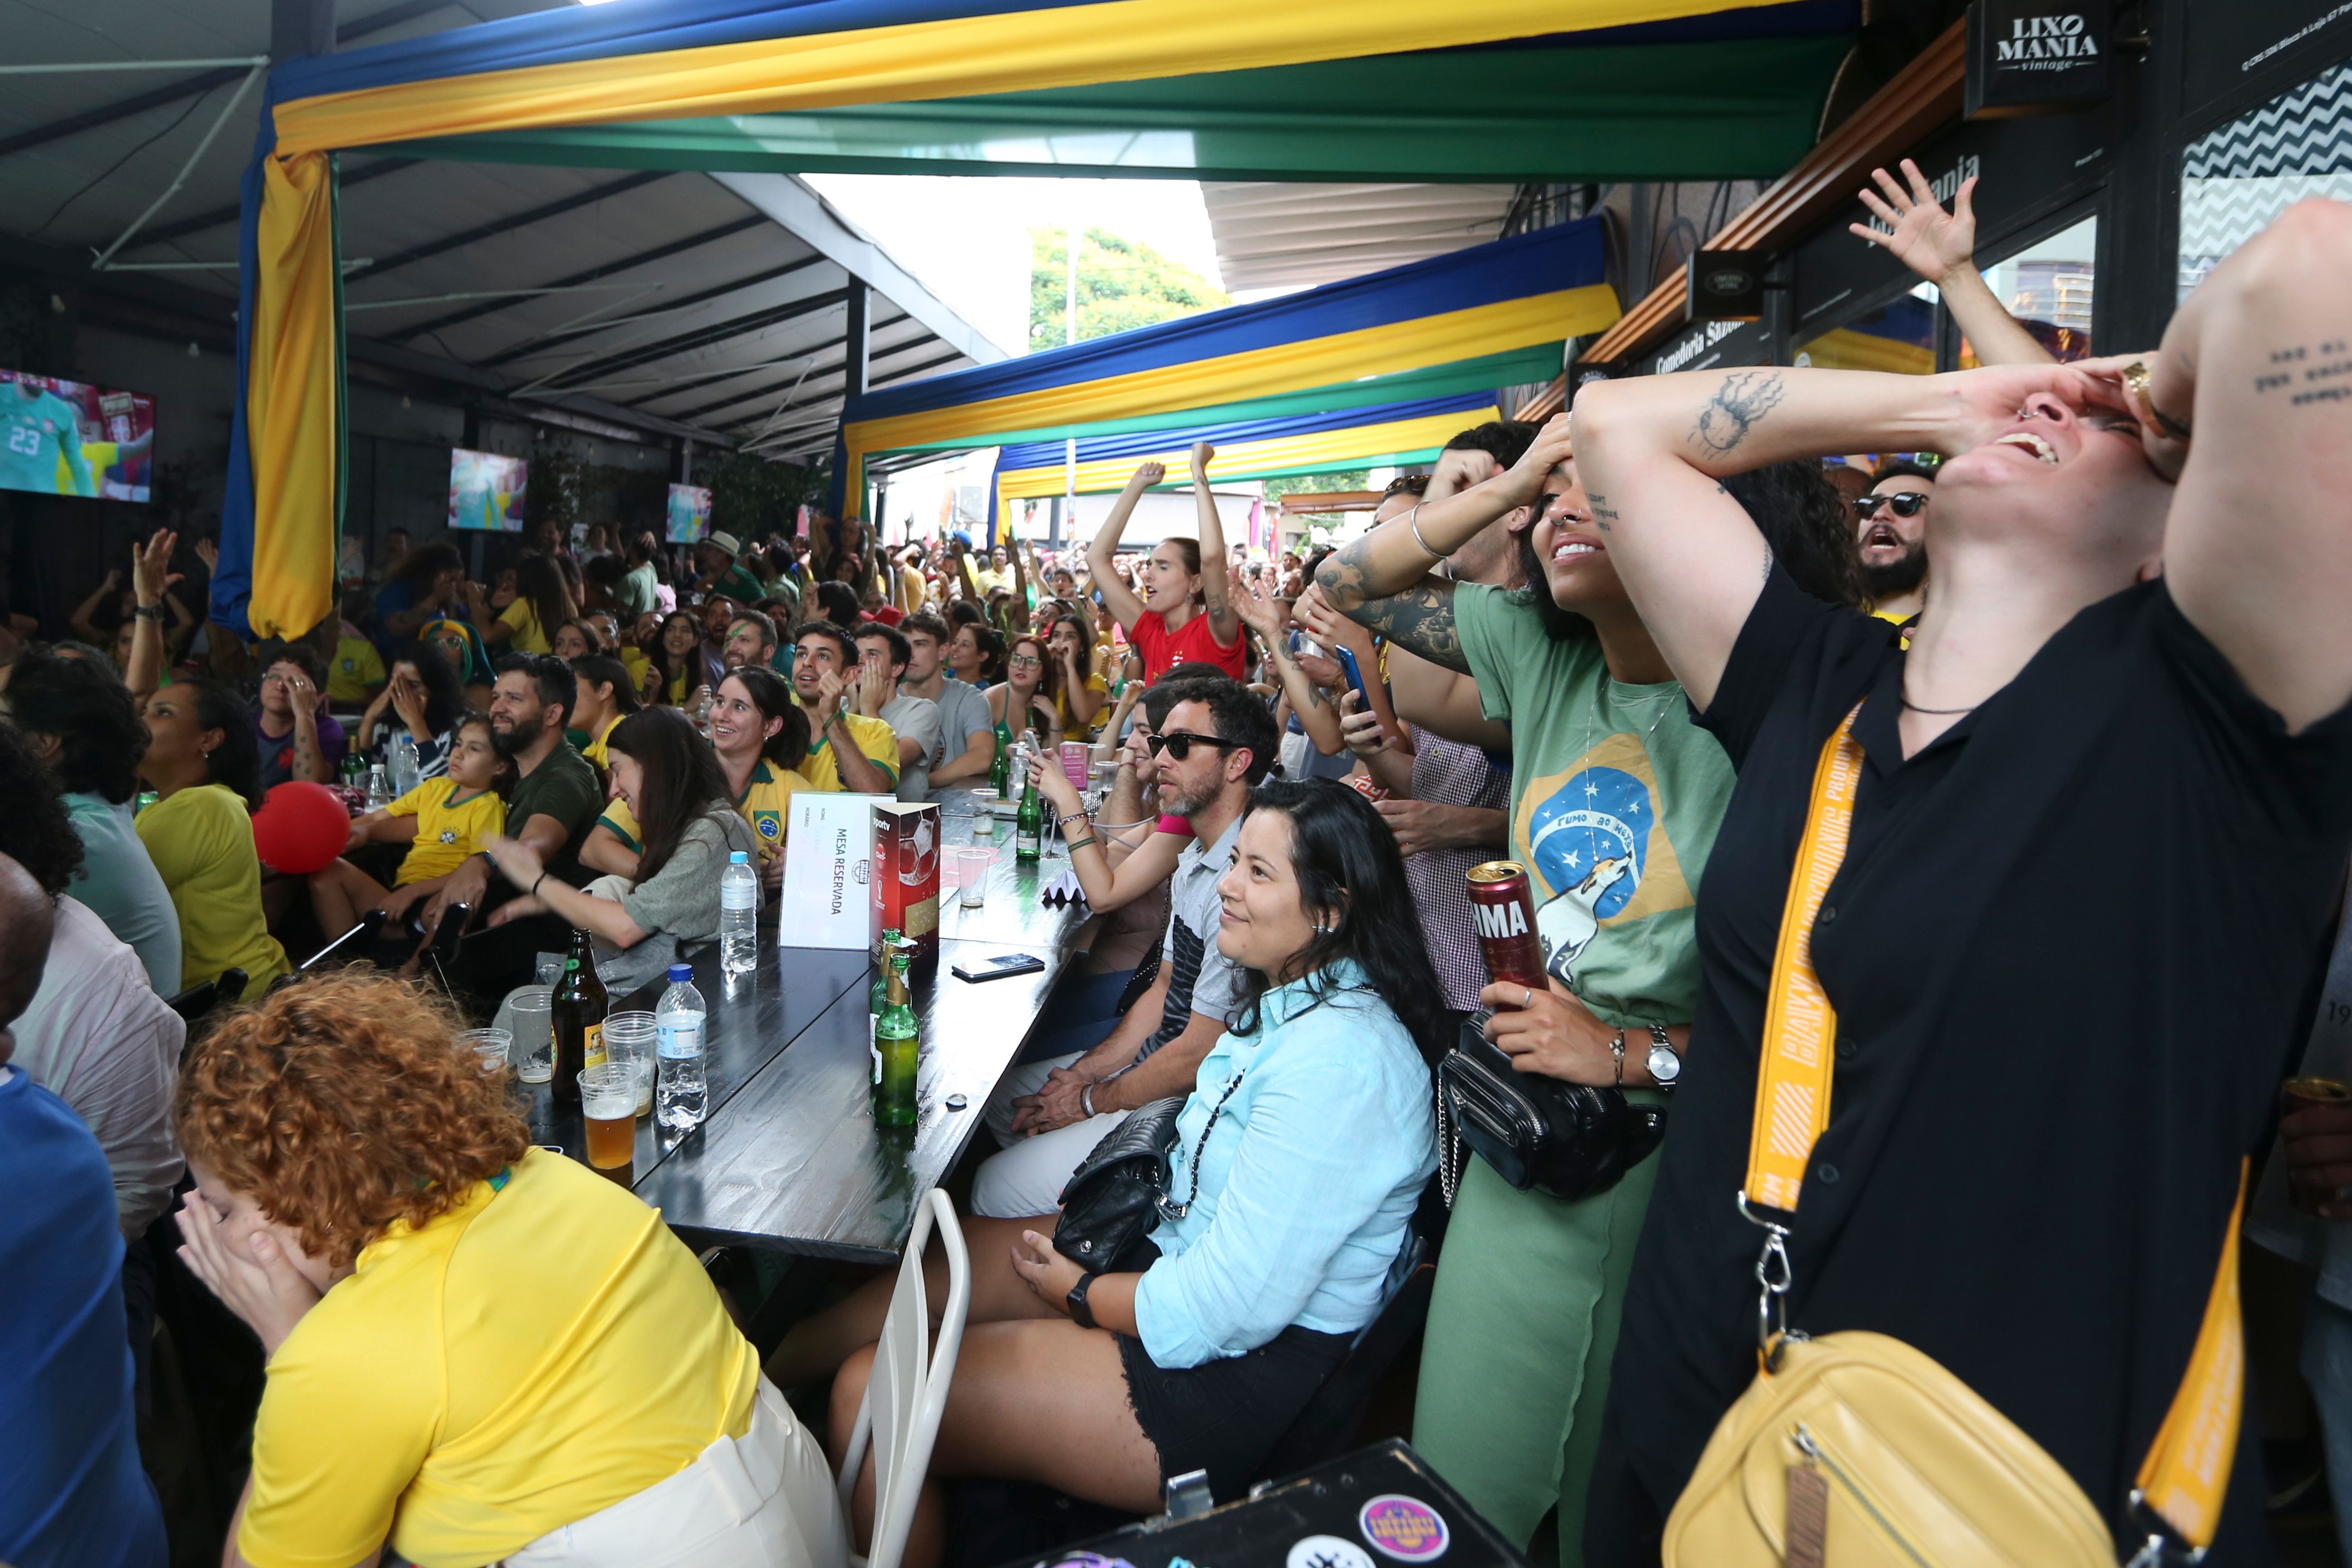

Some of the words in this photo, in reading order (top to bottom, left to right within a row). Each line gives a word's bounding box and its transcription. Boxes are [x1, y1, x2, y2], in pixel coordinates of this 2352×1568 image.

[2012, 15, 2084, 39] LIXO
[2278, 37, 2301, 50] Bloco
[2301, 27, 2308, 37] A
[2308, 17, 2327, 32] Loja
[2327, 9, 2338, 22] 67
[1997, 35, 2099, 61] MANIA
[2021, 60, 2073, 72] vintage
[1656, 332, 1705, 375] Comedoria
[9, 426, 41, 456] 23
[873, 817, 890, 831] sportv
[836, 828, 848, 856] MESA
[831, 858, 845, 916] RESERVADA
